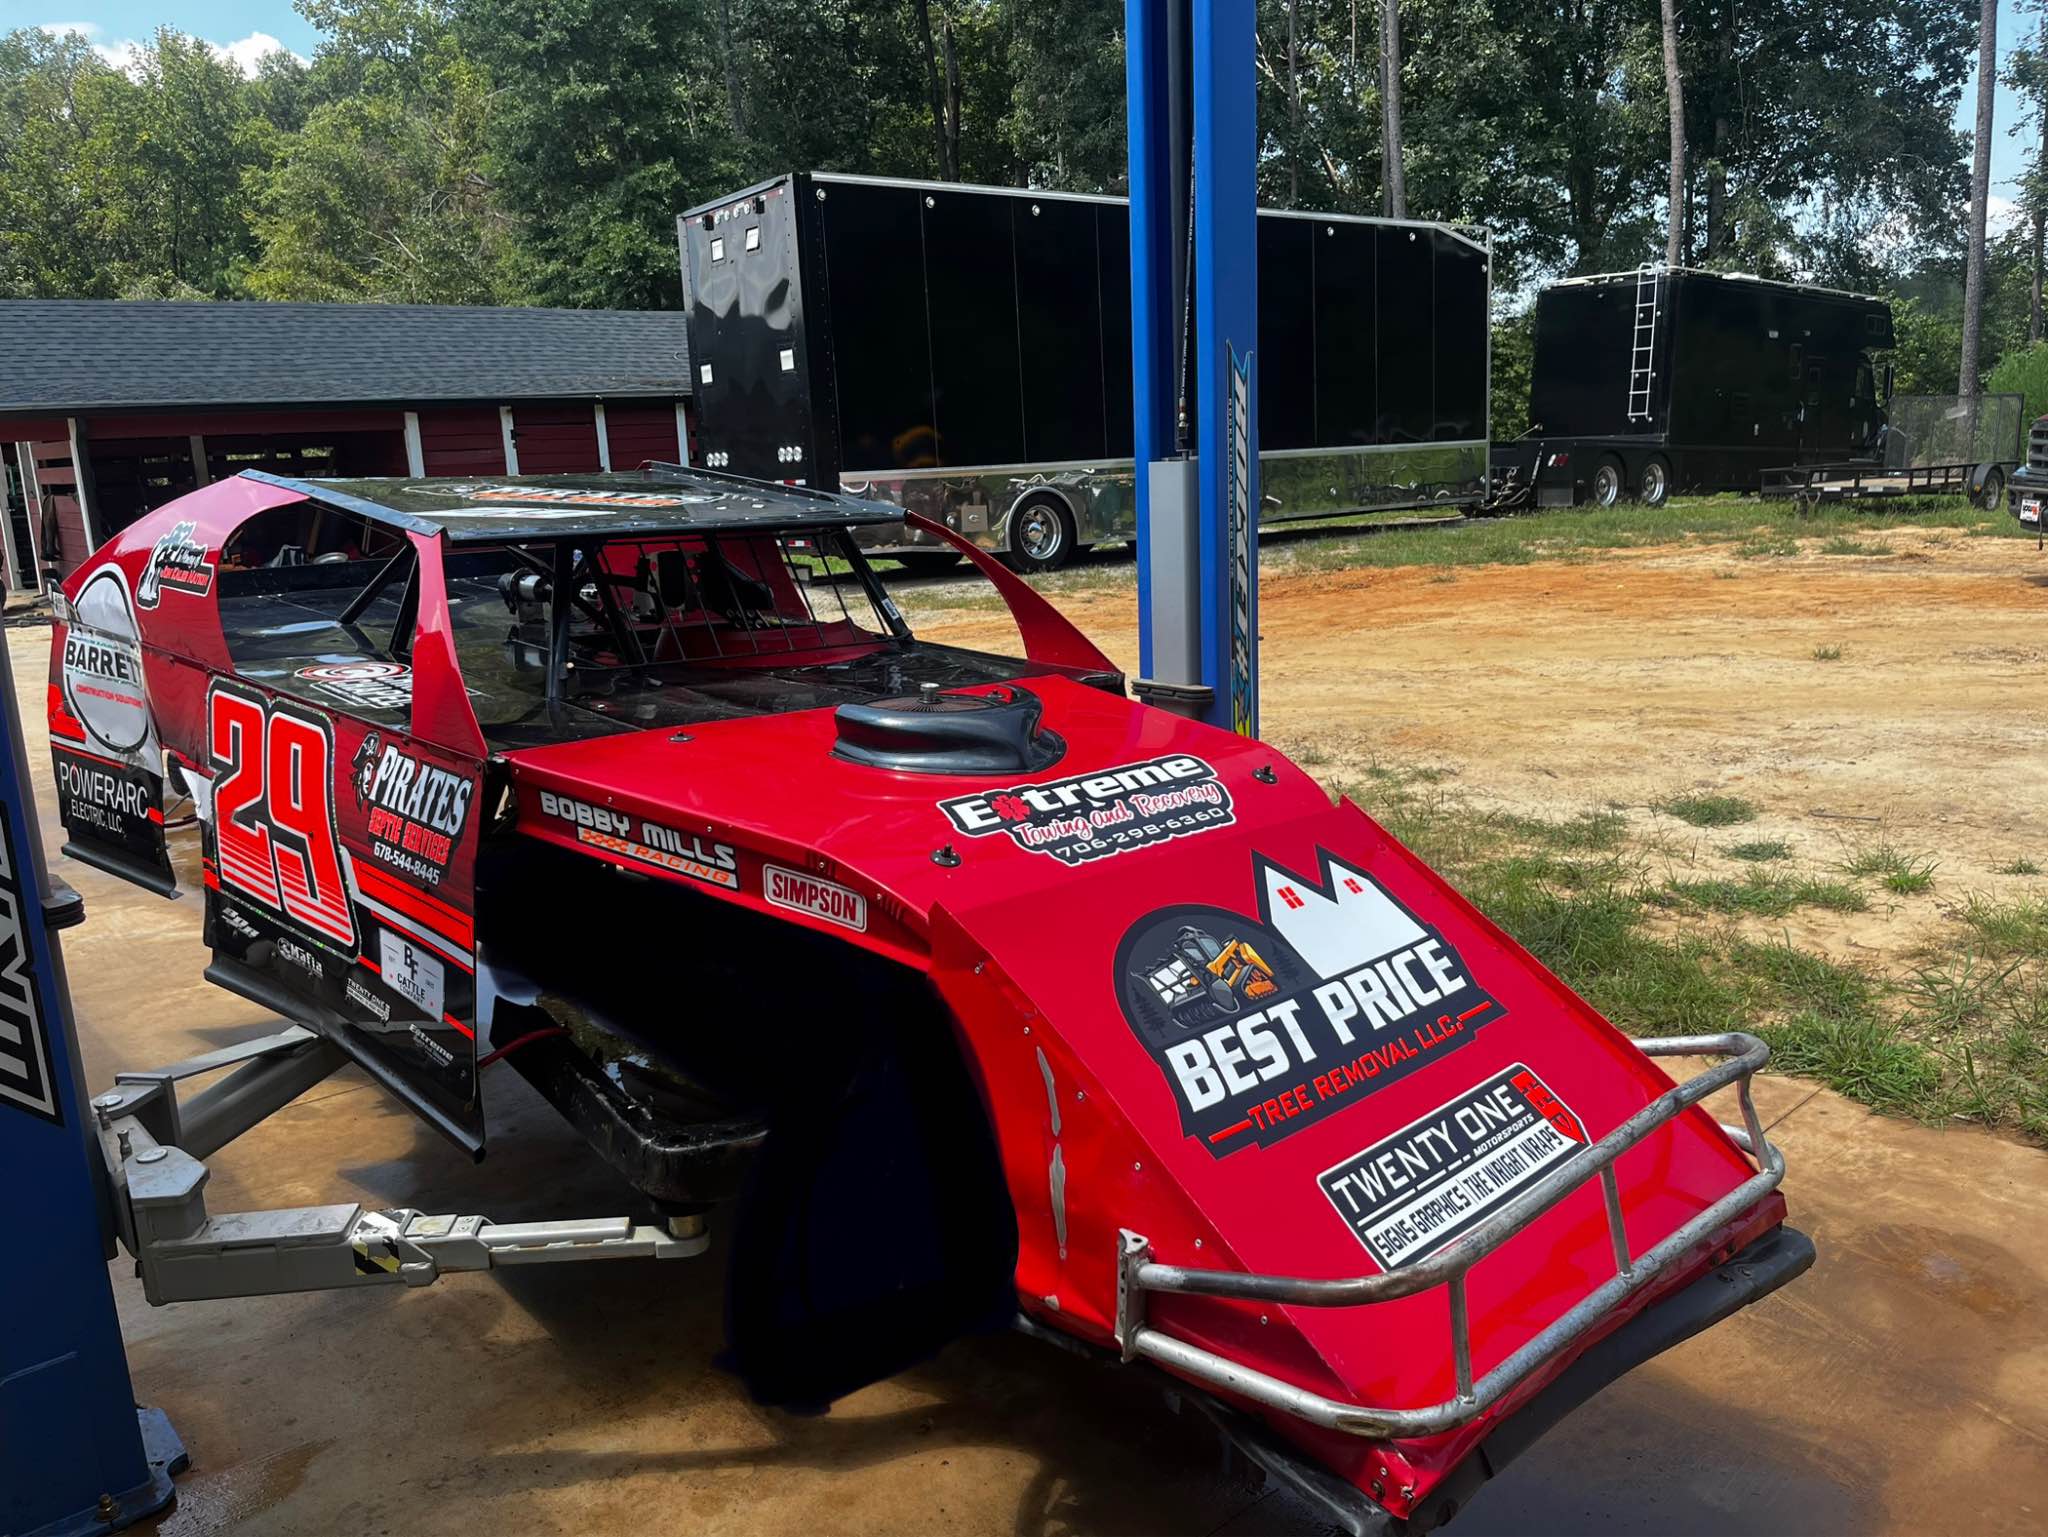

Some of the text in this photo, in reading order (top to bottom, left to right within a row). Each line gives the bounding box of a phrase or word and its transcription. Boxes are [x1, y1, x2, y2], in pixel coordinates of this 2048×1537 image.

[60, 761, 149, 820] POWERARC
[211, 689, 355, 947] 29
[368, 744, 473, 836] PIRATES
[1013, 781, 1222, 846] Towing and Recovery
[368, 806, 453, 866] SEPTIC SERVICES
[540, 790, 737, 870] BOBBY MILLS
[1056, 807, 1226, 858] 706-298-6360
[374, 841, 440, 885] 678-544-8445
[634, 846, 730, 884] RACING
[771, 872, 858, 923] SIMPSON
[397, 972, 425, 1000] CATTLE
[1164, 938, 1468, 1114] BEST PRICE
[1247, 1084, 1314, 1131] TREE
[1313, 1037, 1418, 1101] REMOVAL
[1330, 1083, 1526, 1214] TWENTY ONE
[1463, 1168, 1494, 1201] THE
[1481, 1143, 1531, 1190] WRIGHT
[1519, 1125, 1565, 1166] WRAPS
[1473, 1112, 1536, 1157] MOTORSPORTS
